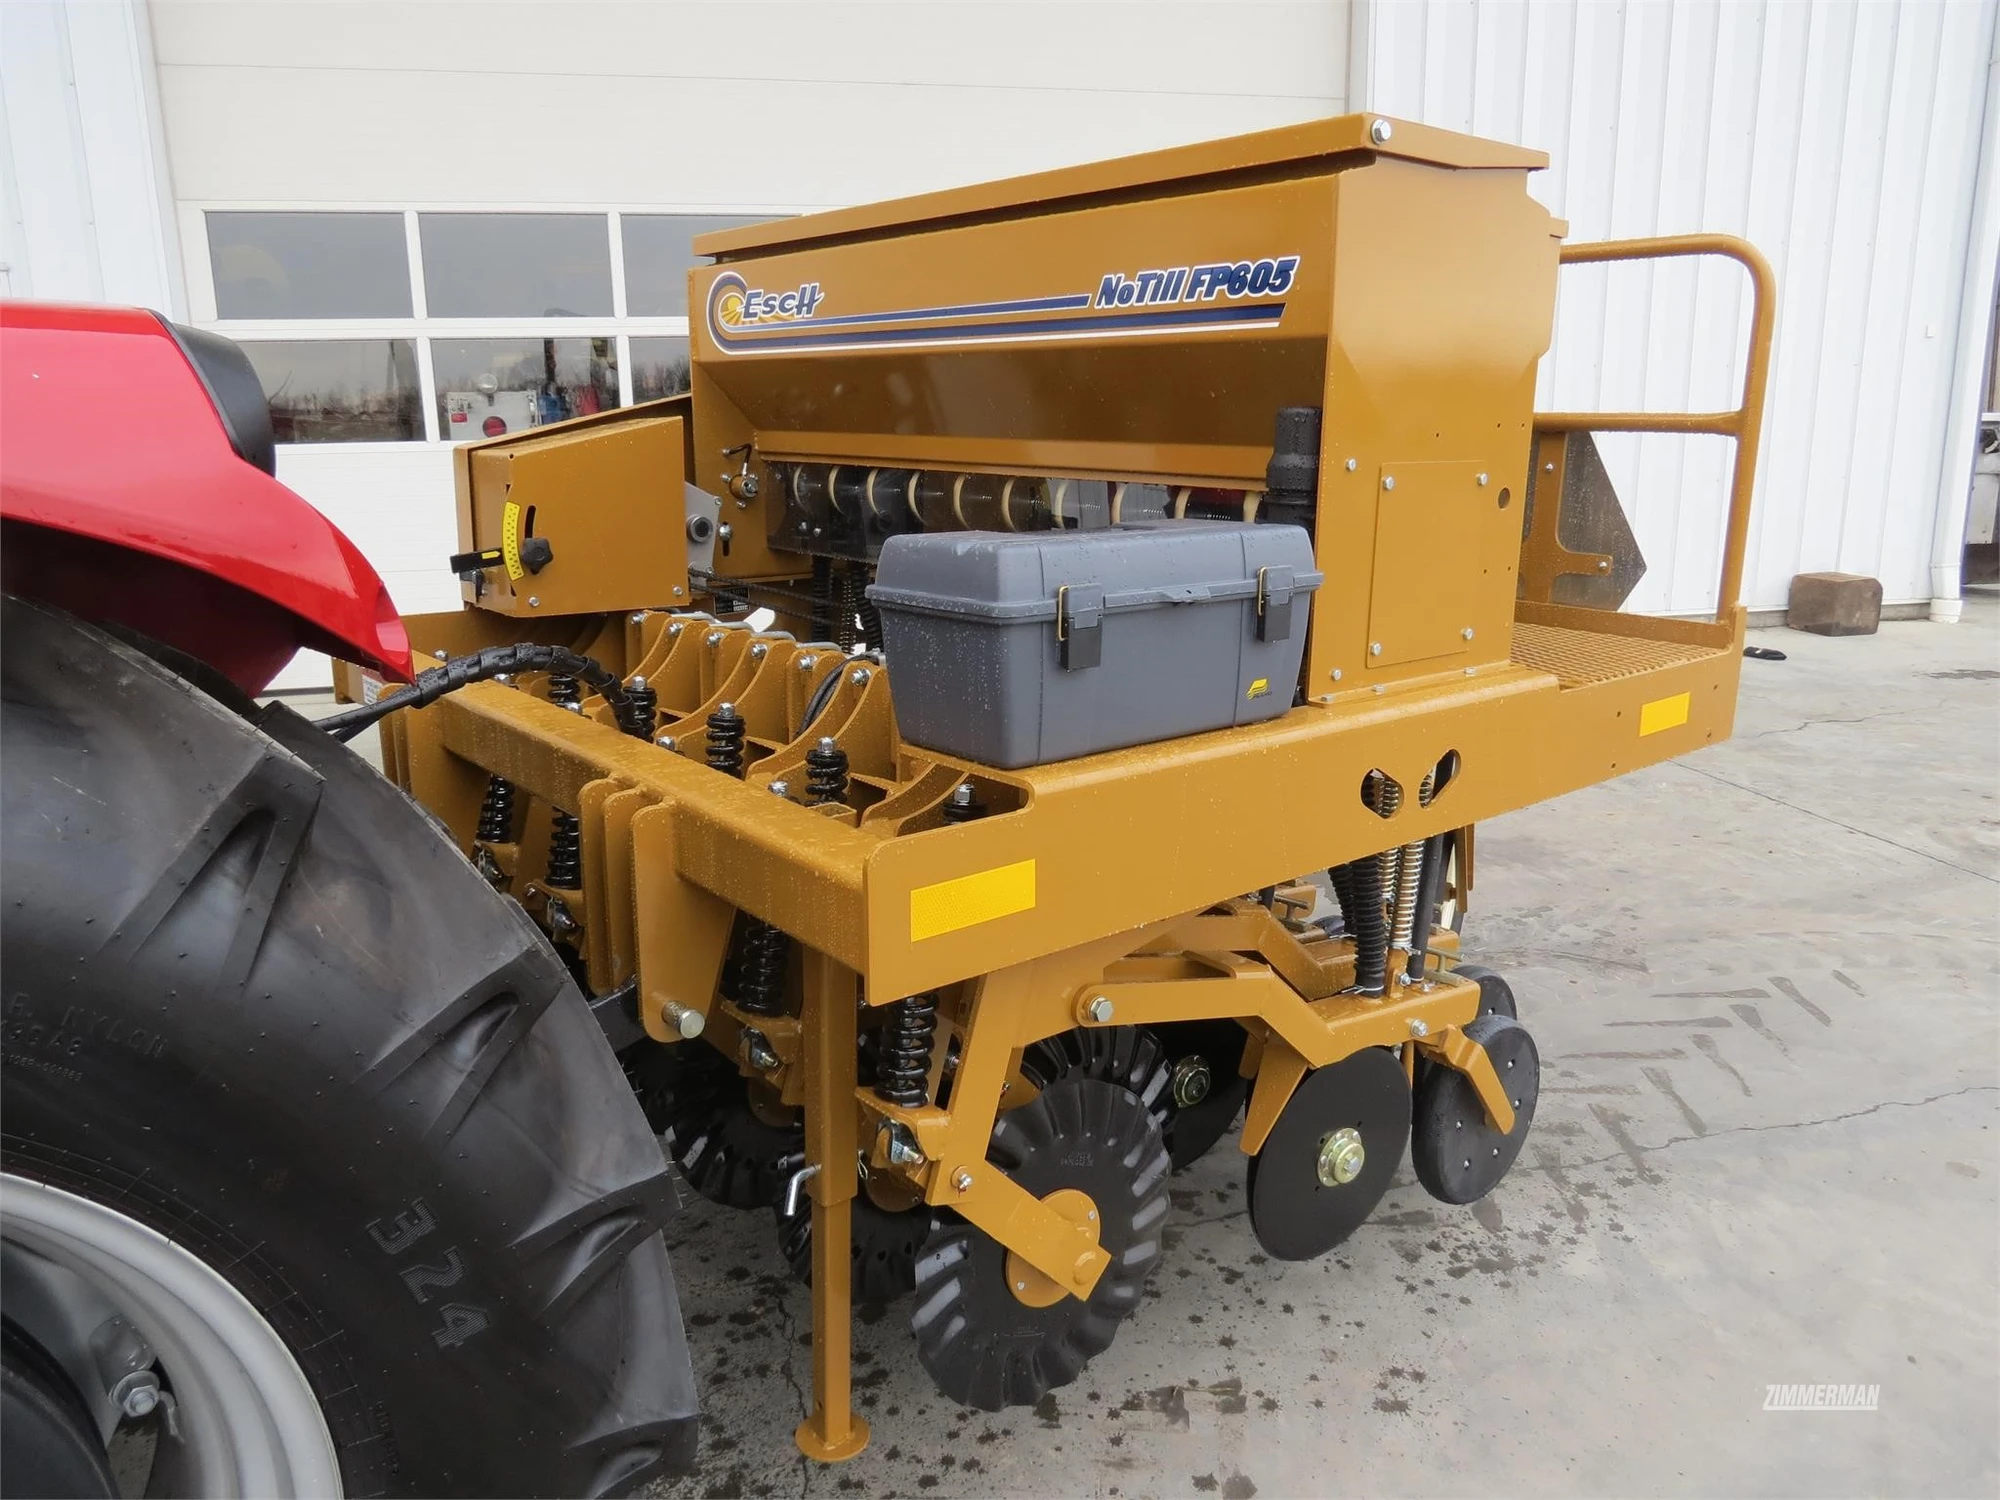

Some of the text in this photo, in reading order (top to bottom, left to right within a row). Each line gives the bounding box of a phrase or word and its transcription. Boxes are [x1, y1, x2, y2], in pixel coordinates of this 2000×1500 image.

[1094, 255, 1300, 310] NoTill FP605
[364, 1197, 492, 1349] 324
